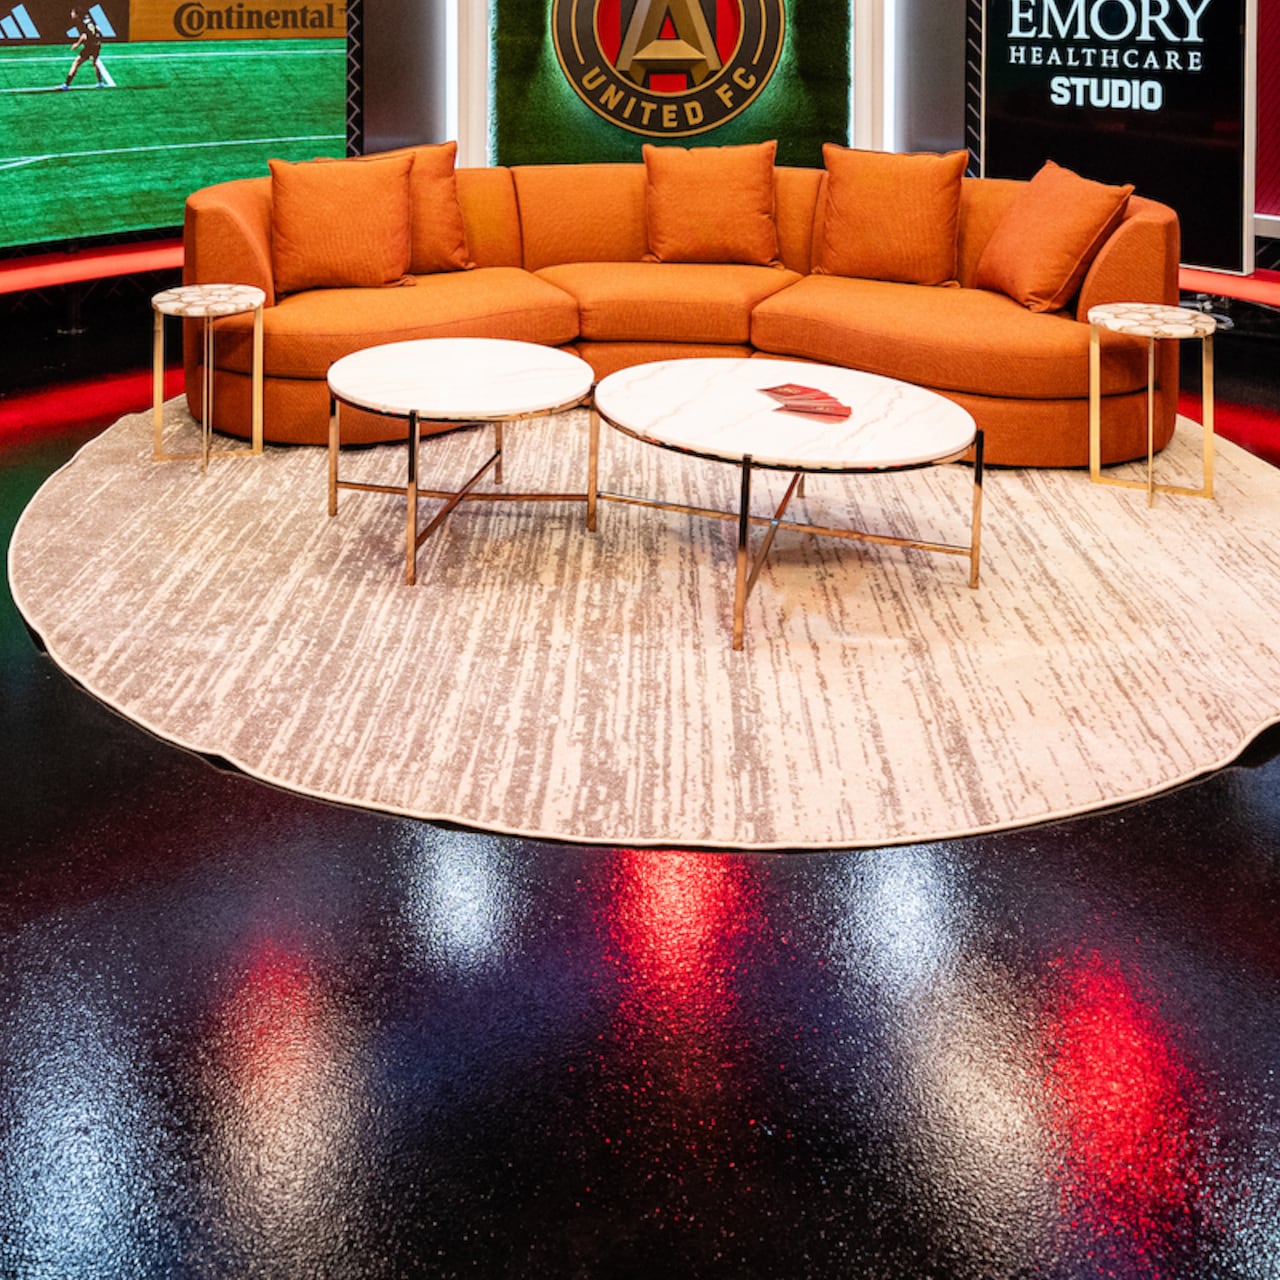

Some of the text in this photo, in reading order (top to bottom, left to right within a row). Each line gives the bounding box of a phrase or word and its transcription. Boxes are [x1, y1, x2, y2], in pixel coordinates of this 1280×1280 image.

[173, 1, 334, 39] Continental
[1009, 46, 1203, 71] HEALTHCARE
[581, 66, 758, 128] UNITED FC
[1050, 76, 1163, 111] STUDIO
